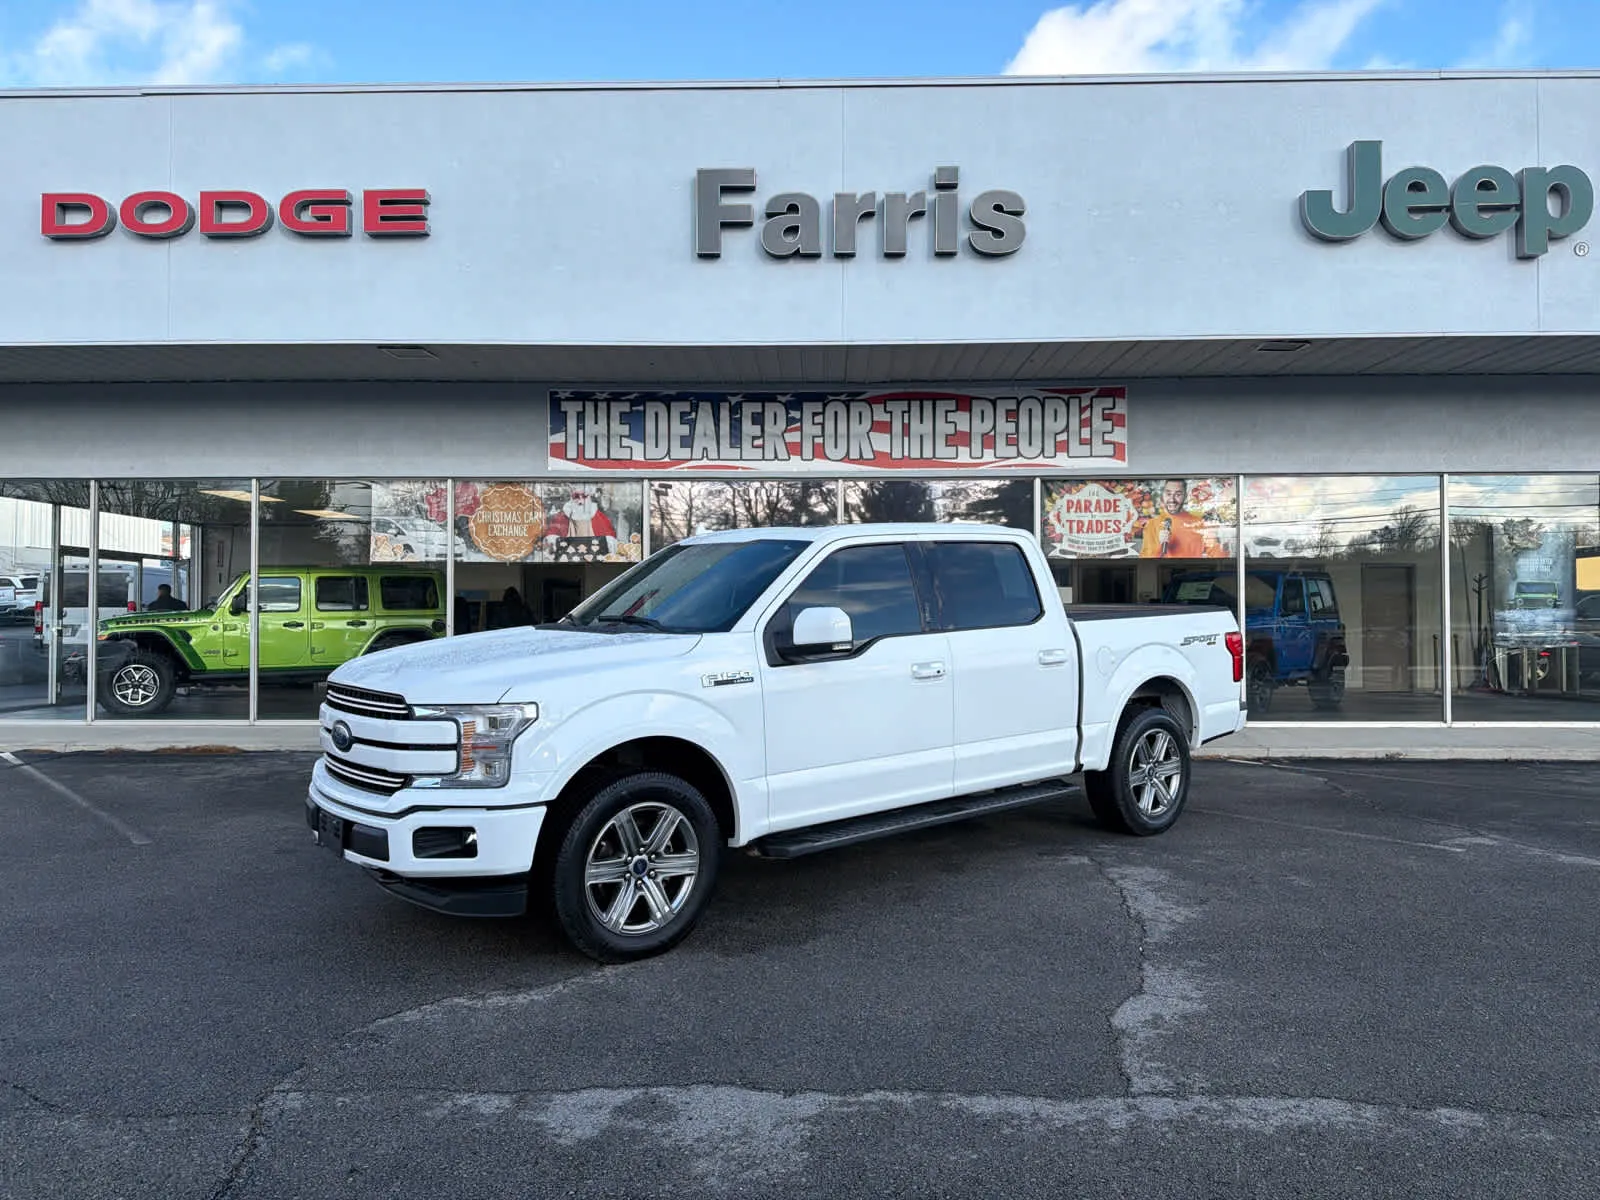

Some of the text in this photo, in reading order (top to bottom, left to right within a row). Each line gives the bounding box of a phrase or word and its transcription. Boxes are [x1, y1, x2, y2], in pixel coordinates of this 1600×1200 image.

[1298, 140, 1594, 258] Jeep
[40, 188, 431, 240] DODGE
[696, 166, 1026, 258] Farris
[560, 396, 1116, 462] THE DEALER FOR THE PEOPLE
[1066, 499, 1121, 513] PARADE
[477, 511, 521, 523] CHRISTMAS
[488, 524, 529, 537] EXCHANGE
[1066, 519, 1122, 534] TRADES
[1180, 633, 1220, 646] SPORT
